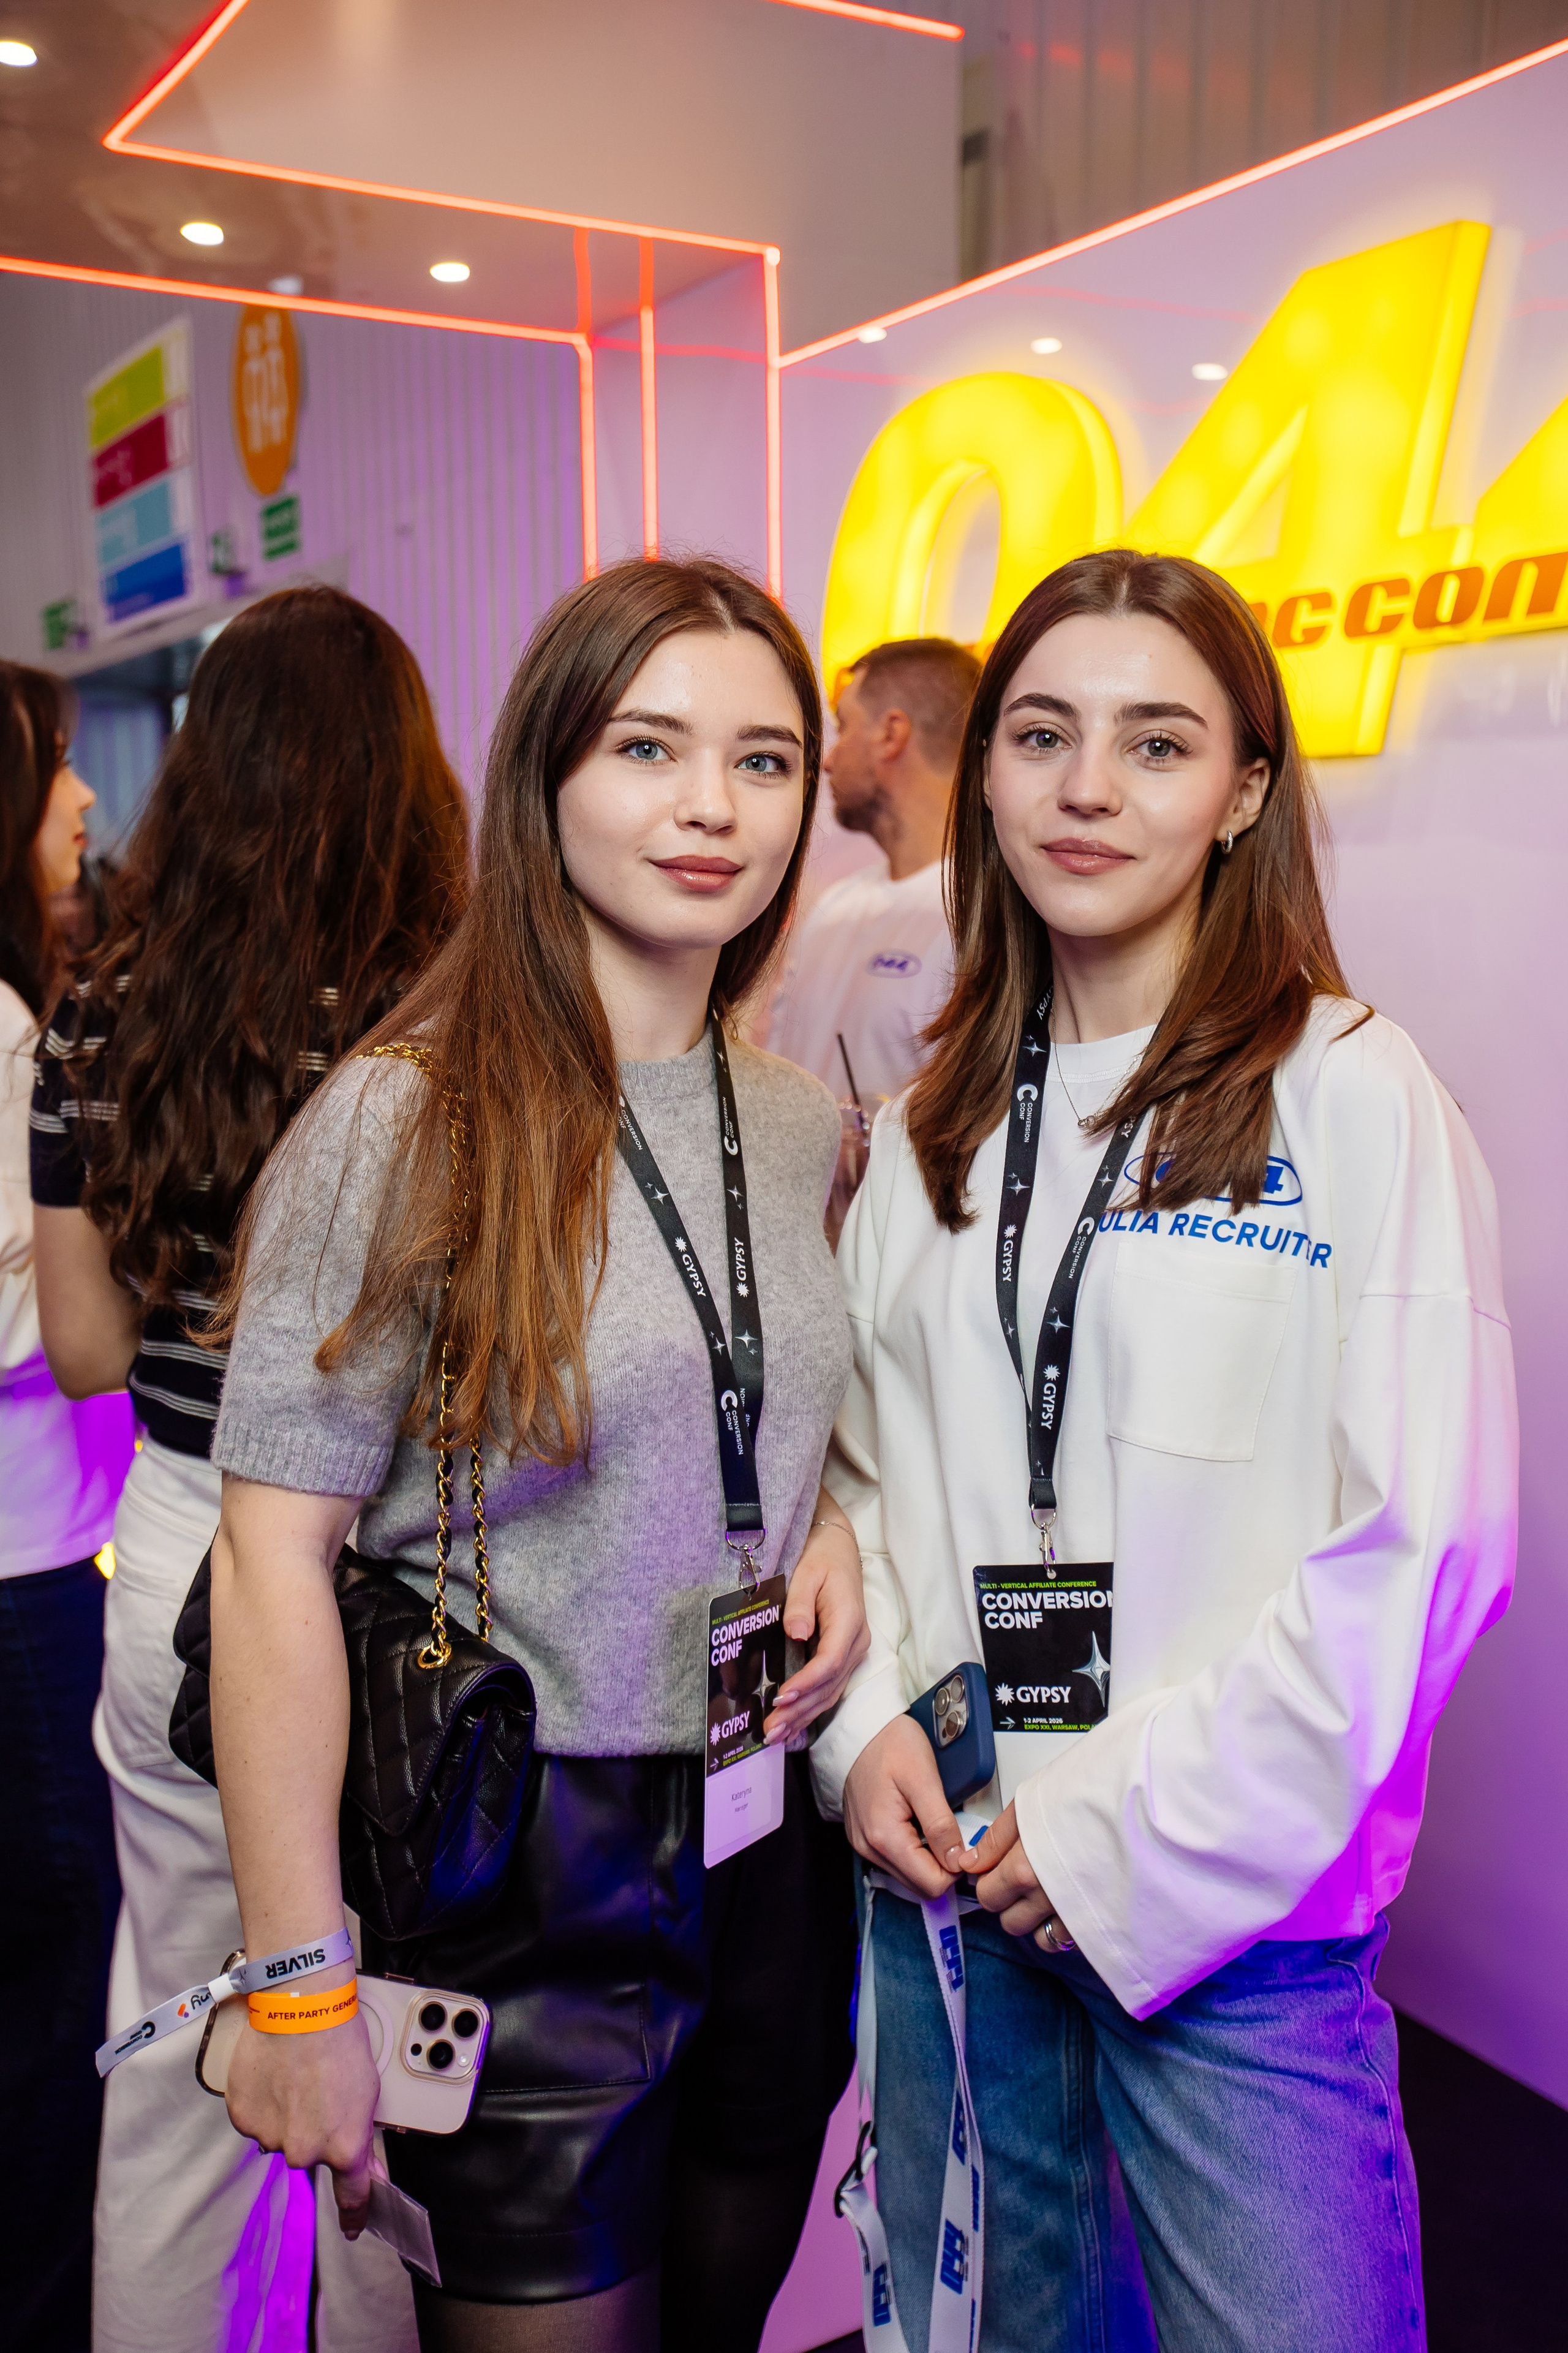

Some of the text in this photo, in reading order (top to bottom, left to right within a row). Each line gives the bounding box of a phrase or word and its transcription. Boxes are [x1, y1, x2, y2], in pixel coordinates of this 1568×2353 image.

[621, 1109, 643, 1150] CONVERSION
[1099, 1209, 1159, 1234] ULIA
[734, 1237, 747, 1281] GYPSY
[1068, 1236, 1087, 1279] CONVERSION
[1072, 1236, 1082, 1254] CONF
[682, 1253, 706, 1297] GYPSY
[1003, 1240, 1013, 1282] GYPSY
[1041, 1383, 1057, 1430] GYPSY
[732, 1410, 744, 1455] CONVERSION
[712, 1604, 779, 1647] CONVERSION
[985, 1611, 1042, 1630] CONF
[711, 1639, 742, 1666] CONF
[1016, 1686, 1071, 1703] GYPSY
[722, 1710, 750, 1739] GYPSY
[731, 1787, 752, 1802] Kateryna
[265, 1949, 326, 1979] SILVER
[299, 2007, 330, 2019] PARTY
